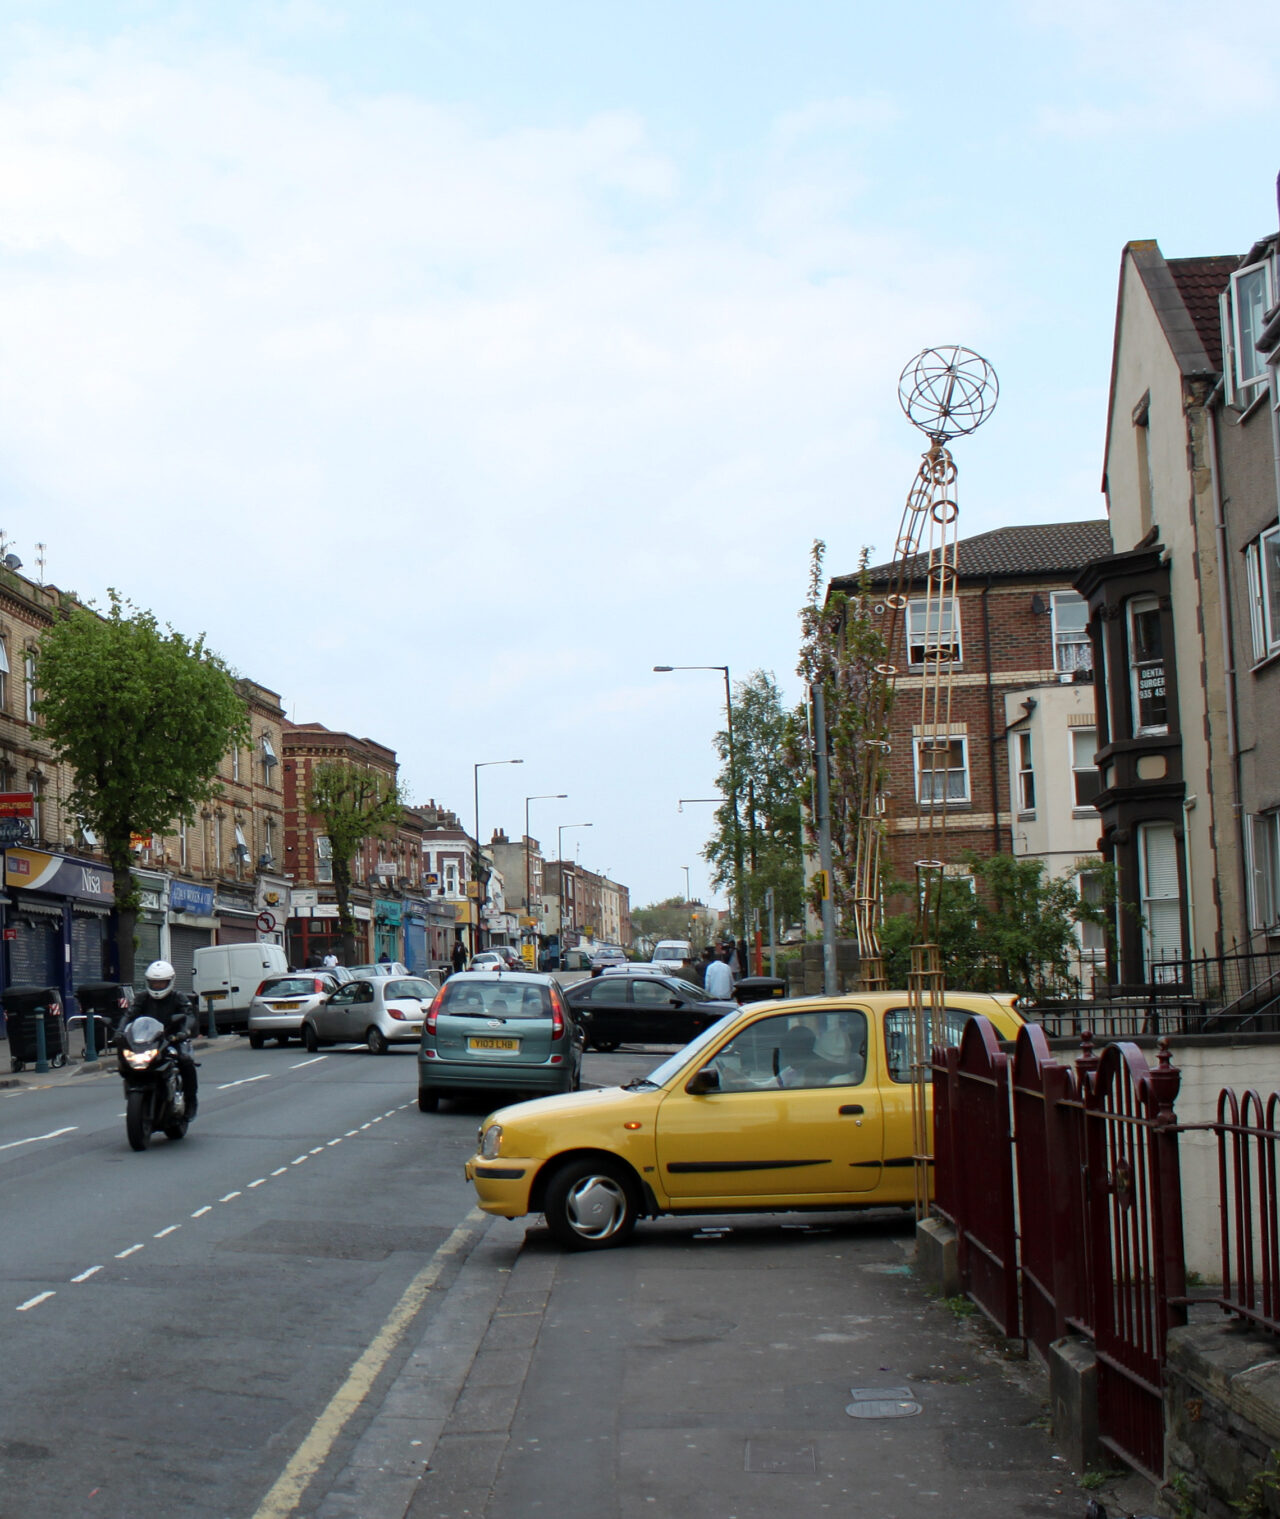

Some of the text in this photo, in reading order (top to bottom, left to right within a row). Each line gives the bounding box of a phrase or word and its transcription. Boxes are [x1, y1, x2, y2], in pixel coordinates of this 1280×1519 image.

[1142, 669, 1163, 678] DENTA
[81, 867, 101, 894] Nisa
[475, 1040, 513, 1049] Y103 LHB
